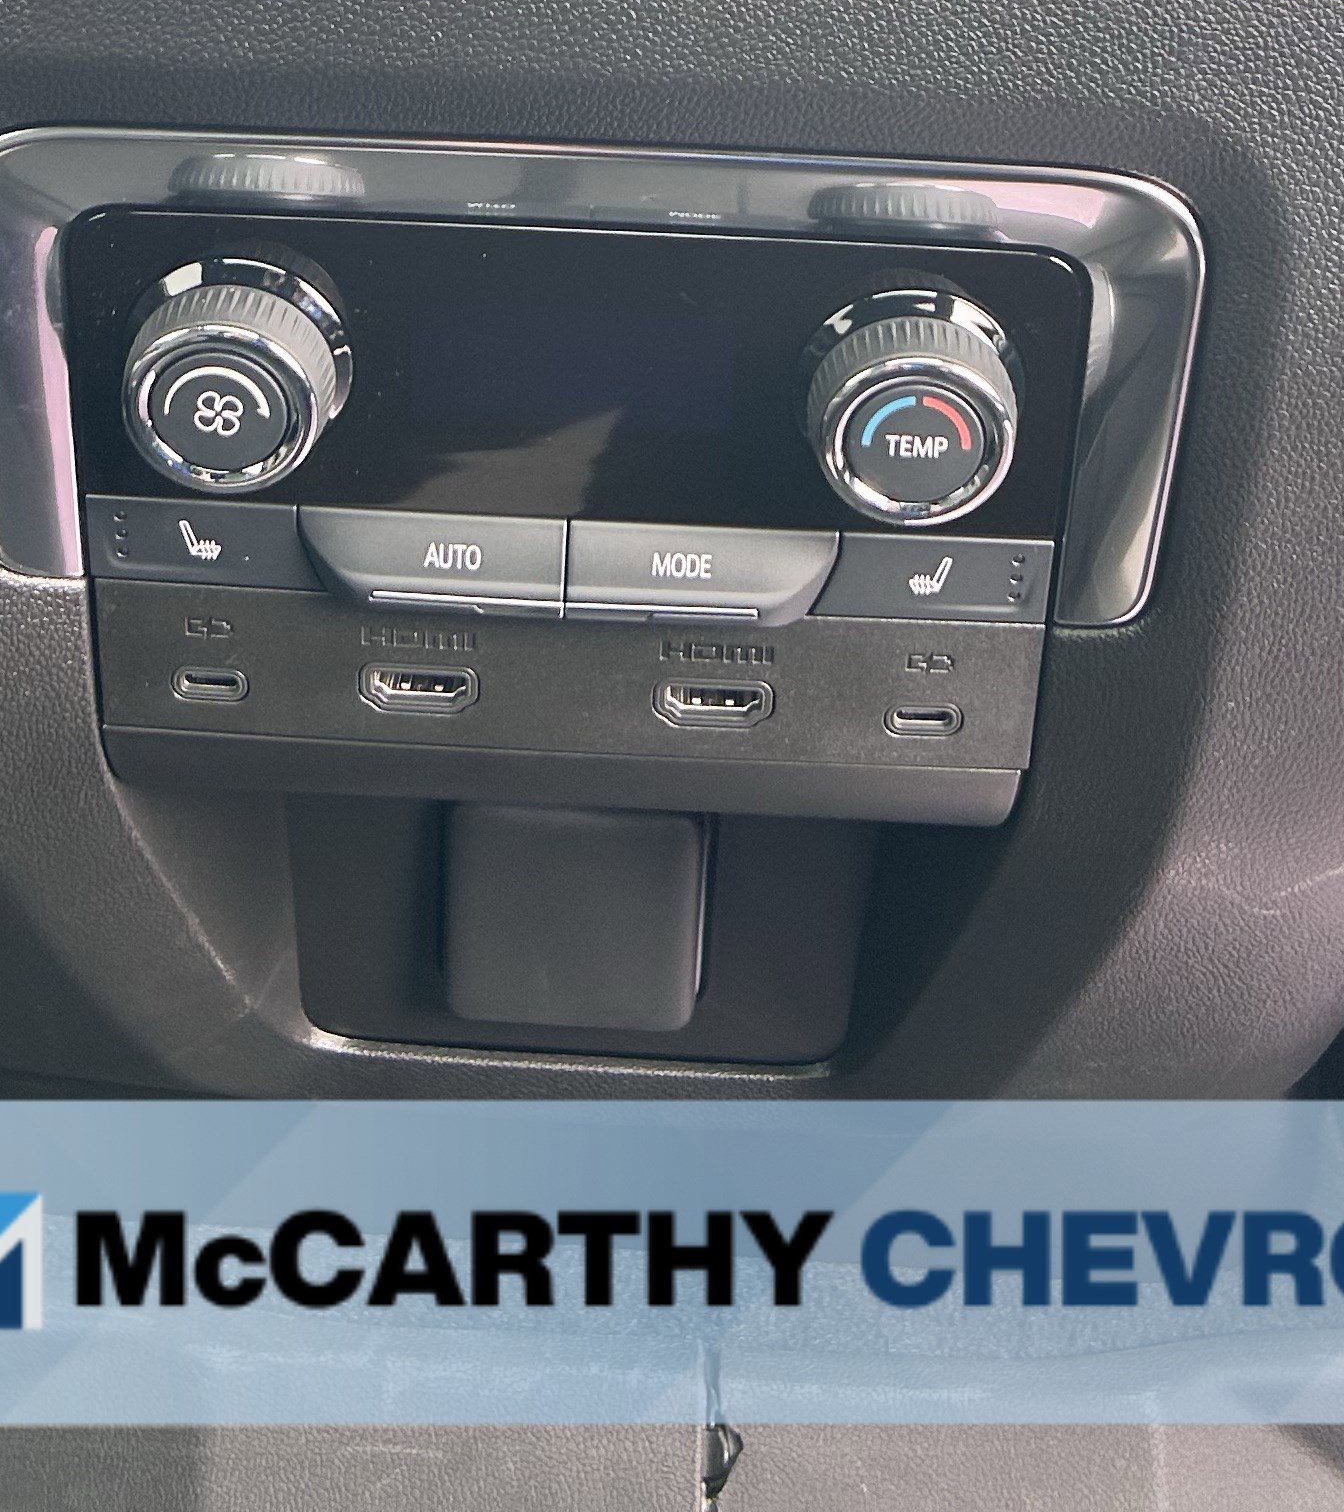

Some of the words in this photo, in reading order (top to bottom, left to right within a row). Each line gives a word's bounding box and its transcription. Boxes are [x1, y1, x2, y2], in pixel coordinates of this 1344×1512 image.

[885, 434, 949, 459] TEMP
[423, 541, 483, 572] AUTO
[650, 551, 714, 580] MODE
